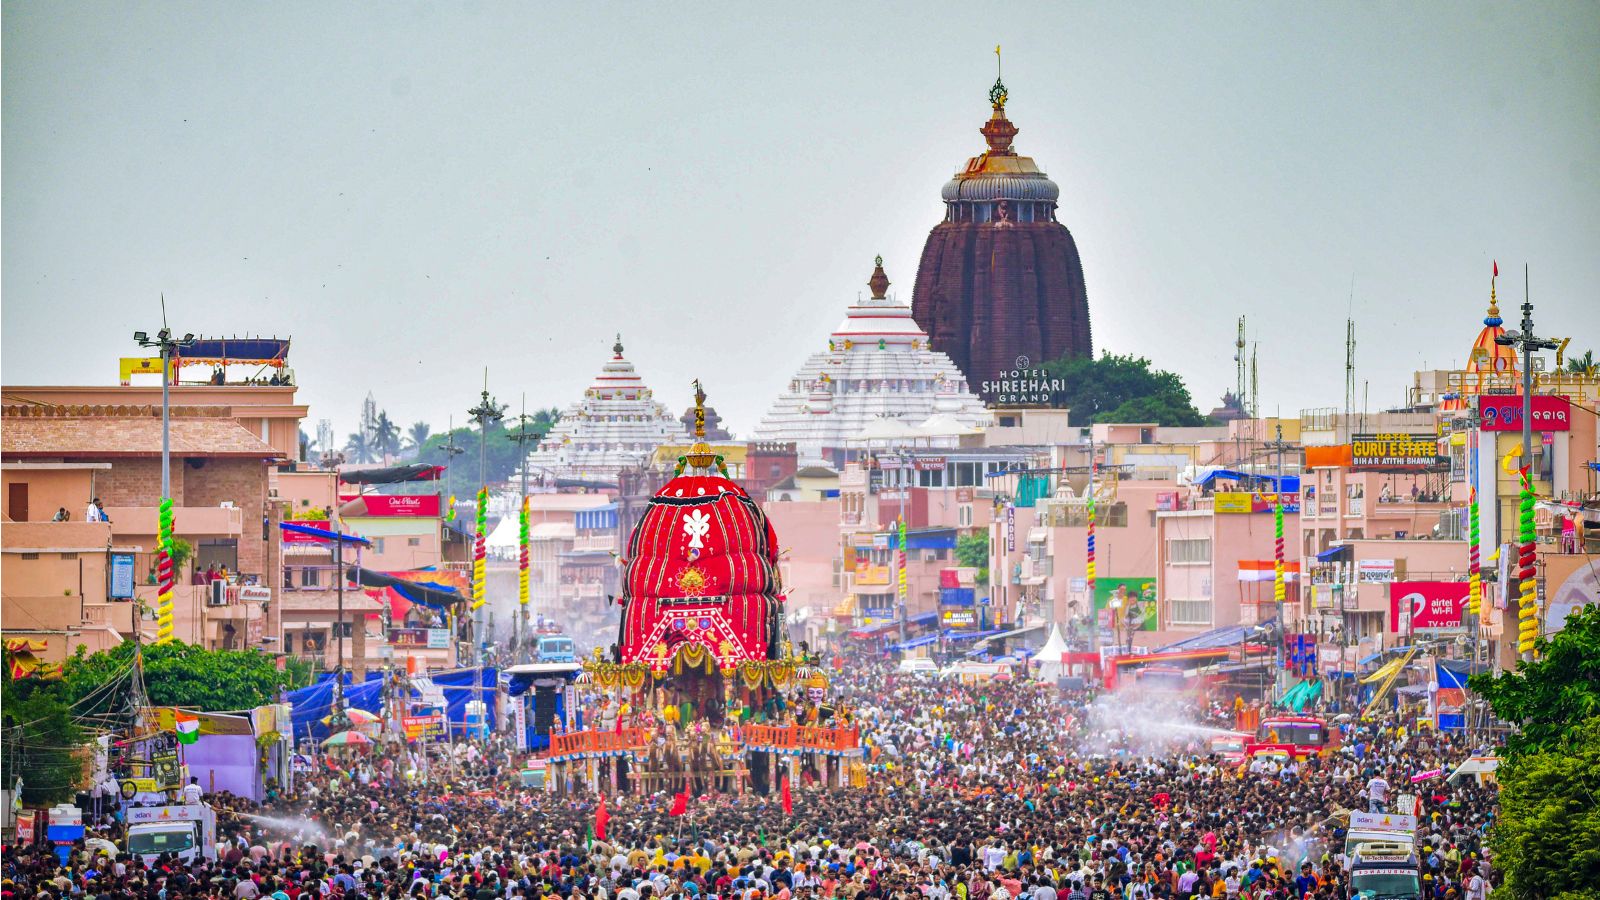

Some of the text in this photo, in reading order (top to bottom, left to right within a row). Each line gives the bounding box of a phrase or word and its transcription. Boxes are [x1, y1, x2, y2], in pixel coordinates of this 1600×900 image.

[1000, 369, 1047, 378] HOTEL
[982, 379, 1065, 393] SHREEHARI
[999, 394, 1049, 402] GRAND
[1376, 433, 1412, 441] HOTEL
[1353, 441, 1436, 457] GURU ESTATE
[1353, 457, 1436, 465] BIHAR ATITHI BHAWAN
[1431, 598, 1453, 607] airtel
